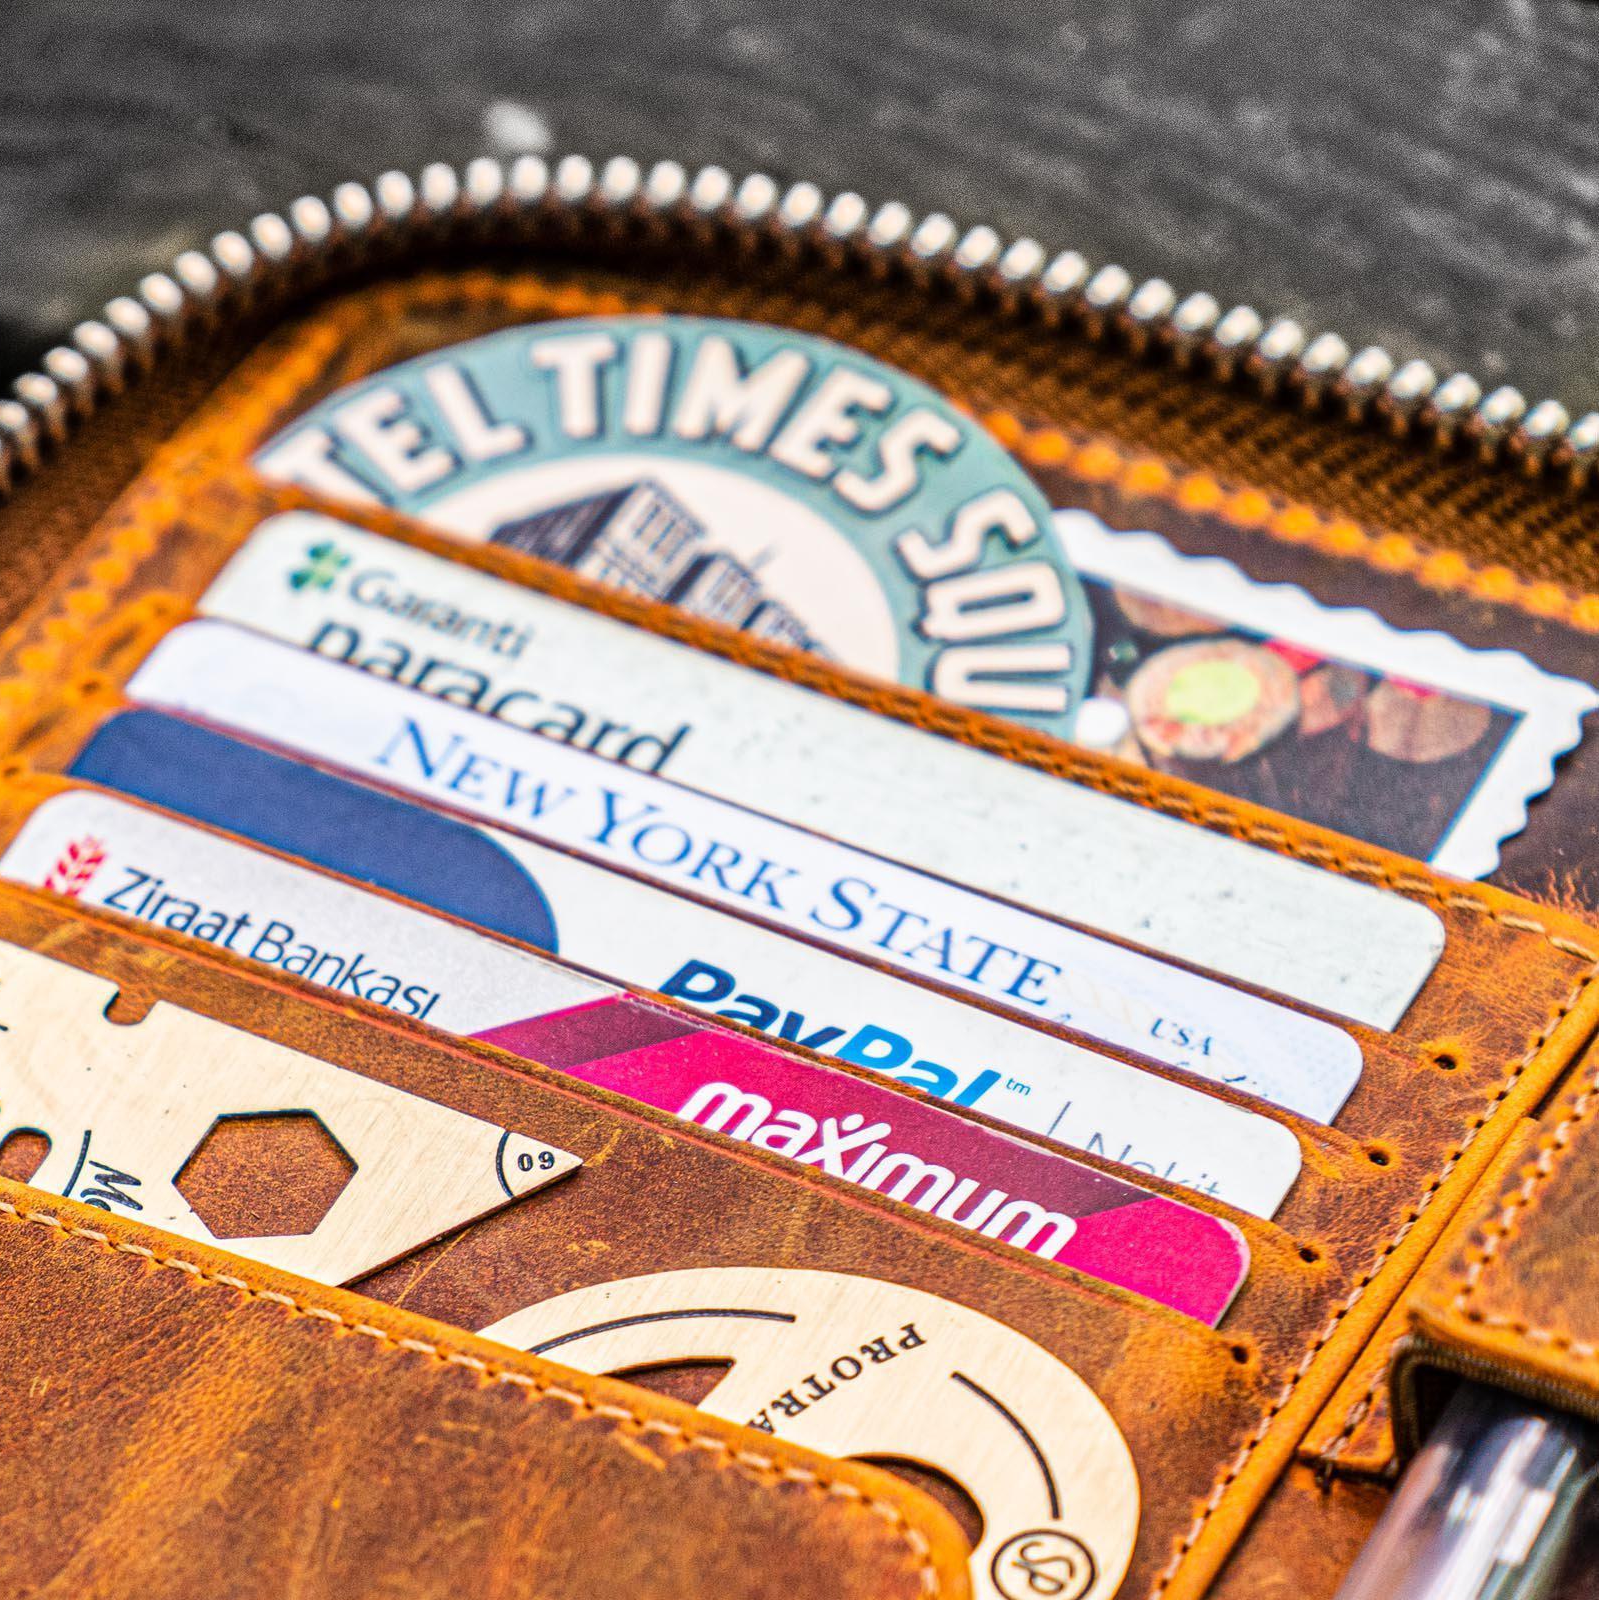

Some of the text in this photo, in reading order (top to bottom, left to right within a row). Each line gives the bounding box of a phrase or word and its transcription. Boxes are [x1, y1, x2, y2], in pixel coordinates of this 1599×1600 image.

[530, 331, 965, 514] TIMES
[891, 487, 1071, 714] SQU
[348, 568, 534, 661] Garanti
[102, 866, 254, 950] Ziraat
[372, 716, 1063, 1007] NEW YORK STATE
[1150, 1017, 1214, 1057] USA
[675, 1081, 1078, 1261] maximum
[747, 1322, 928, 1436] PROTRA
